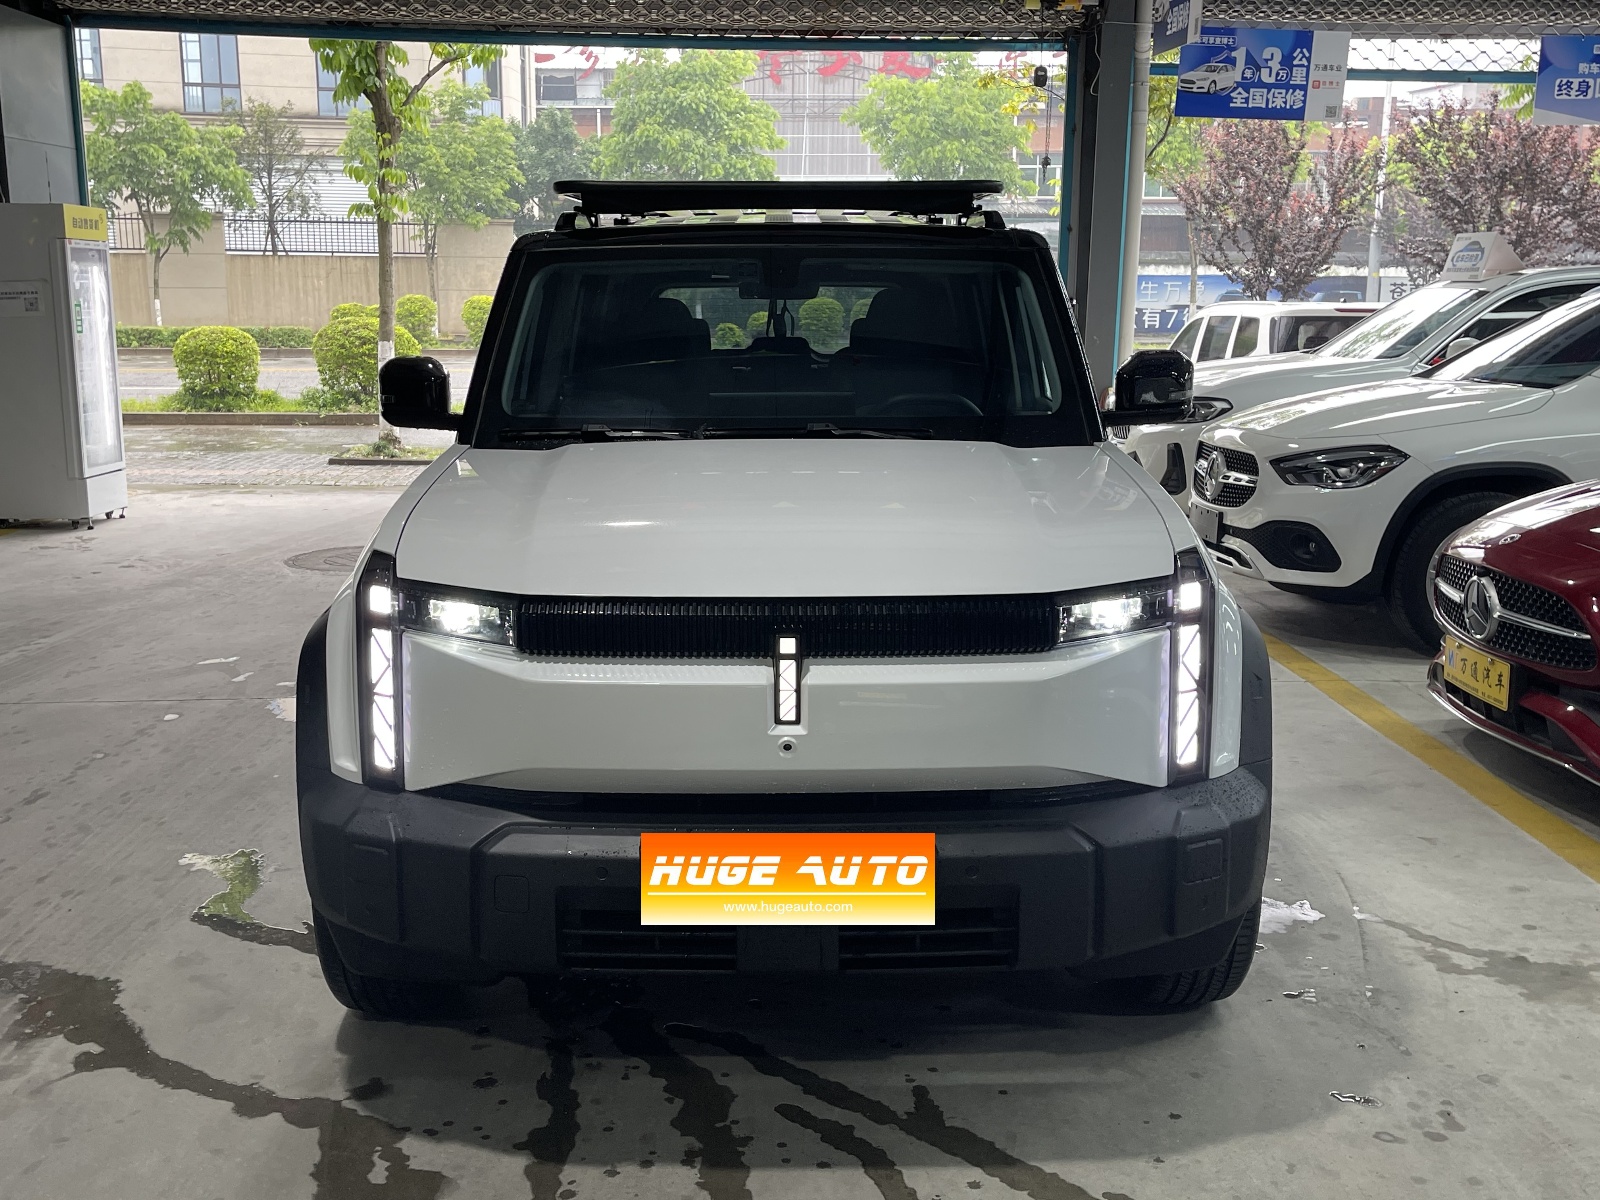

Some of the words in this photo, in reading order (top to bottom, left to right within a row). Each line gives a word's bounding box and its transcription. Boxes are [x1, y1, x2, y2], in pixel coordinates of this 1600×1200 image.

[1313, 63, 1343, 72] 万通车业
[1229, 87, 1305, 109] 全国保修
[1556, 79, 1592, 97] 终身
[1460, 657, 1505, 694] 万通汽车
